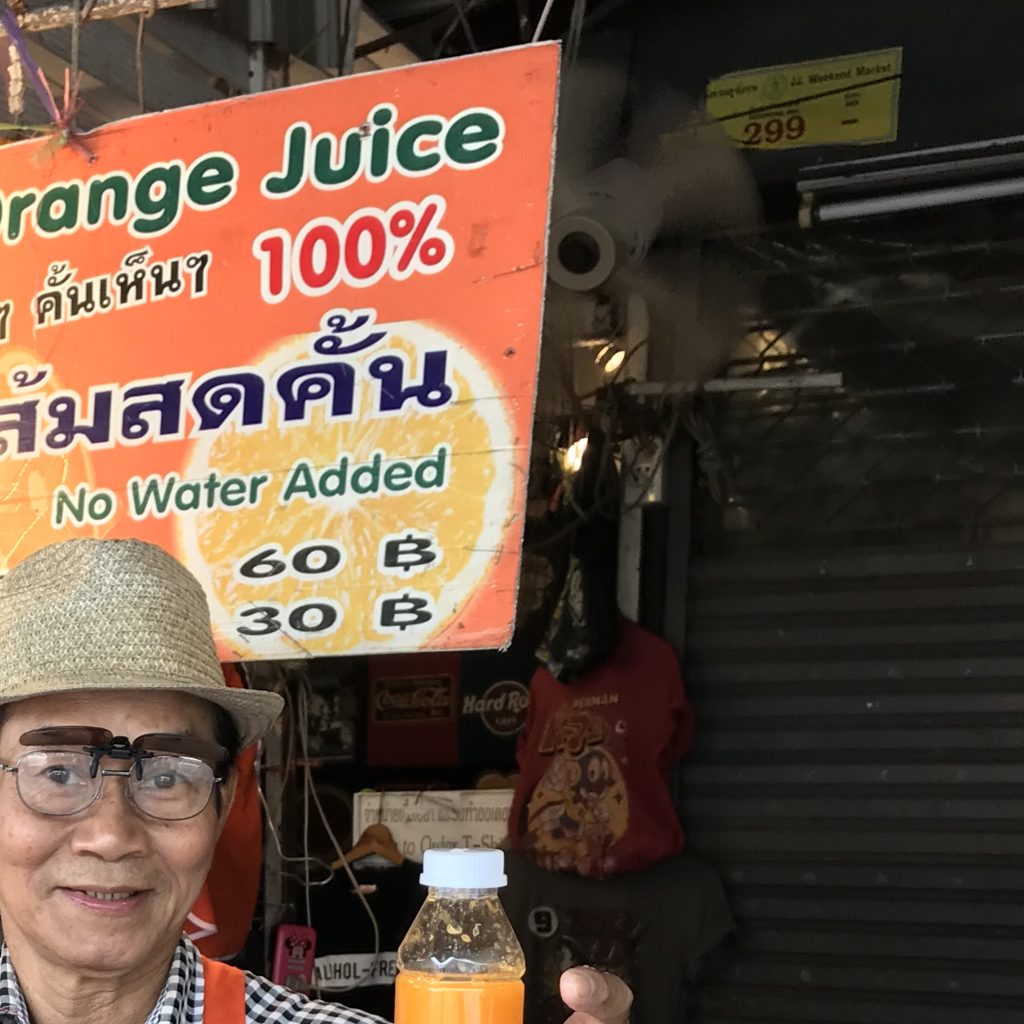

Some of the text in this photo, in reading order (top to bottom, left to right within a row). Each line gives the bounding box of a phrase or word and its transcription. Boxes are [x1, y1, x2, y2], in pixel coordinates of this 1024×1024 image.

[742, 114, 807, 147] 299
[264, 106, 502, 195] Juice
[35, 249, 211, 326] คั้นเห็นๆ
[259, 202, 448, 297] 100%
[54, 447, 448, 525] No Water Added
[238, 544, 342, 579] 60
[235, 602, 339, 637] 30
[462, 692, 507, 715] Hard
